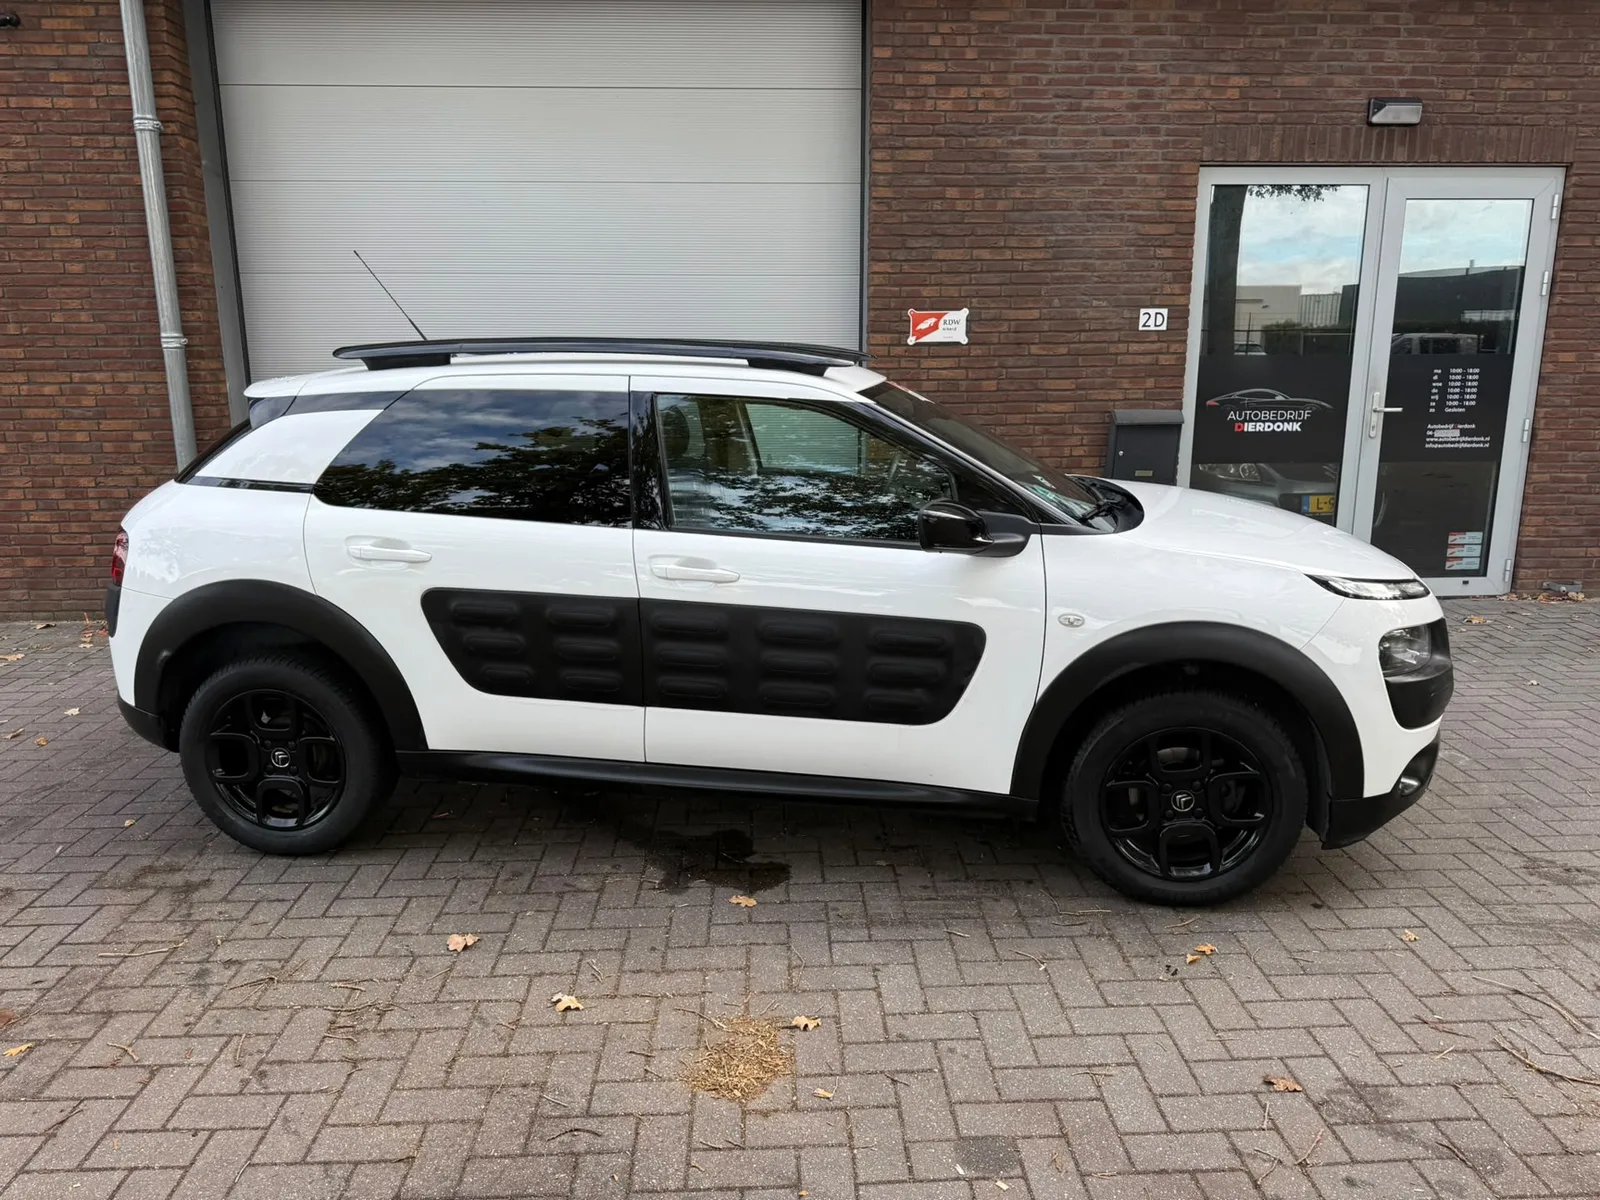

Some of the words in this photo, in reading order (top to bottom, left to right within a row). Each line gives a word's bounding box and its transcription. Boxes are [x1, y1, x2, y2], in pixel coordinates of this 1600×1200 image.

[1141, 312, 1165, 328] 2D
[1227, 410, 1312, 420] AUTOBEDRIJF
[1234, 422, 1302, 432] DIERDONK
